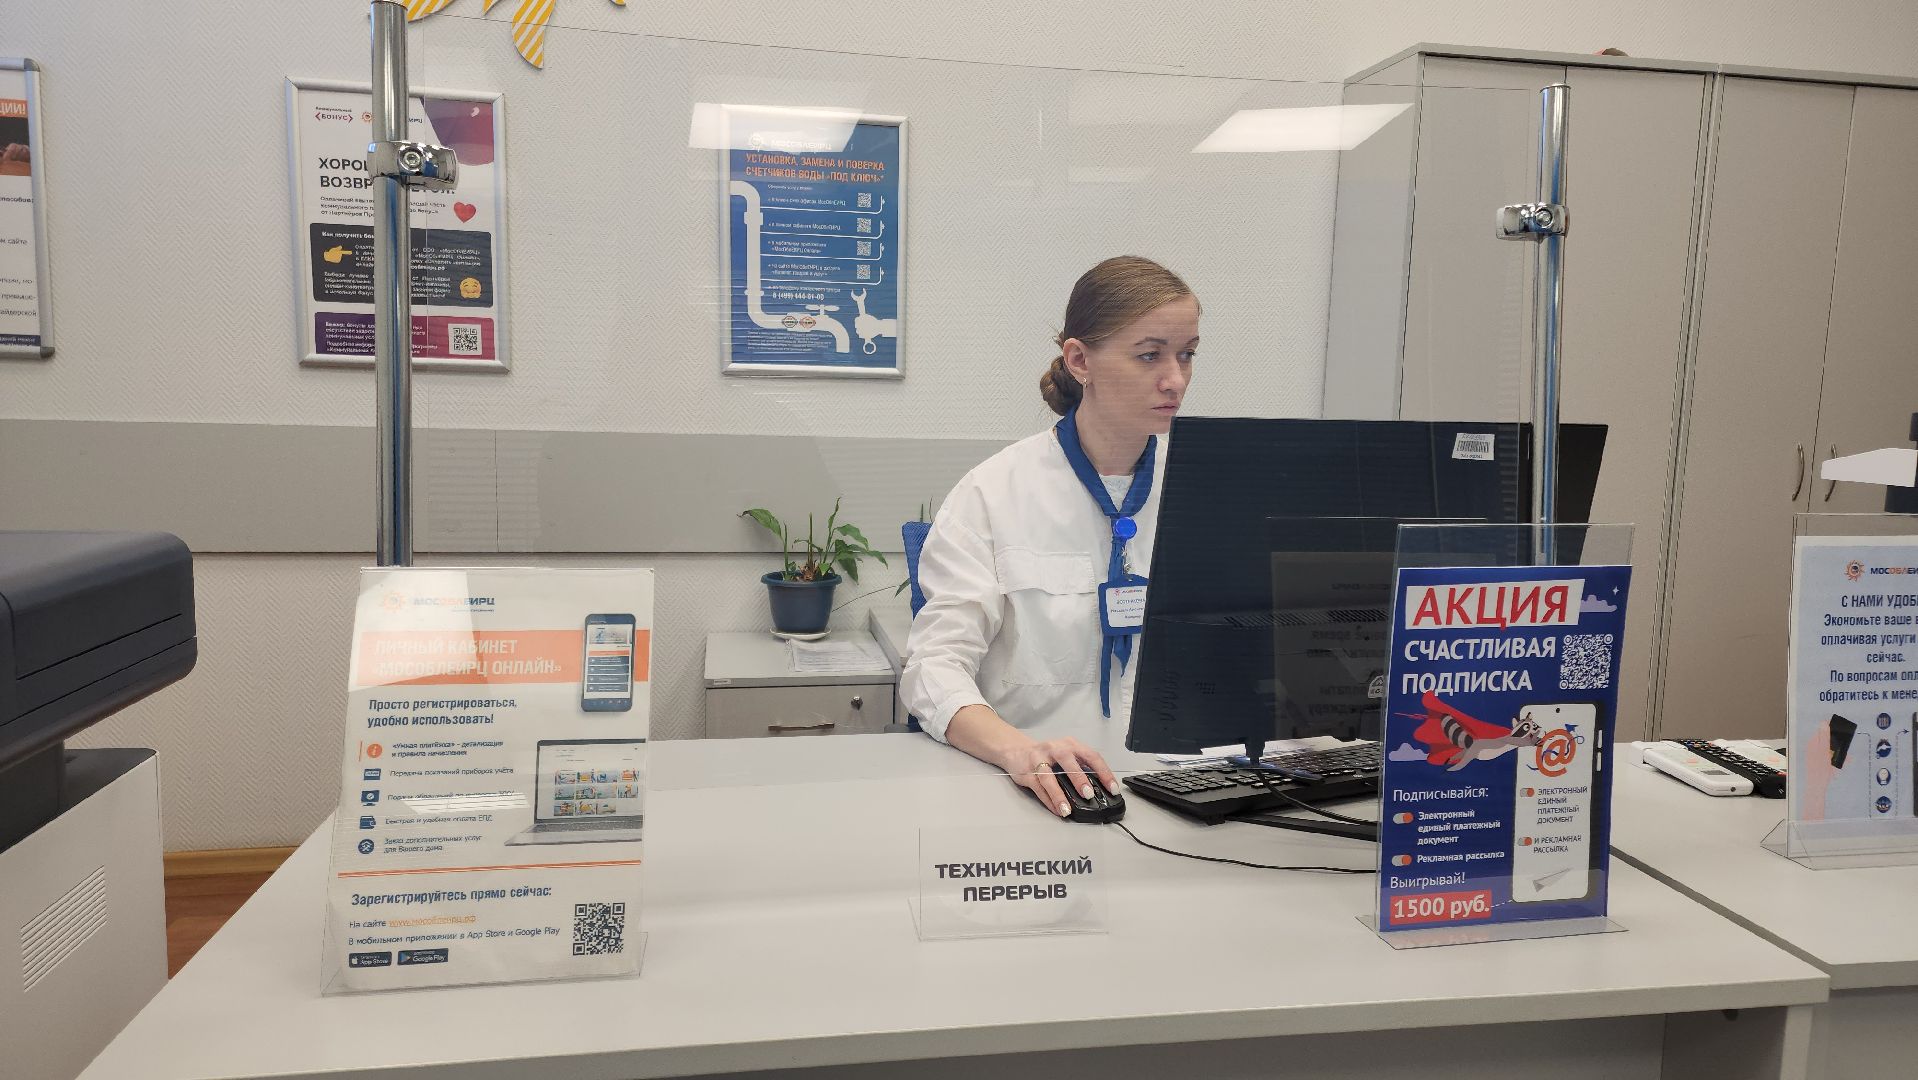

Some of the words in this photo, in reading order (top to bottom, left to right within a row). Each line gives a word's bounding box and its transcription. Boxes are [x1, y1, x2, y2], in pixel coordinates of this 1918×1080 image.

[745, 153, 799, 166] УСТАНОВКА,
[800, 156, 835, 167] ЗАМЕНА
[837, 158, 844, 167] И
[845, 159, 885, 171] ПОВЕРКА
[745, 166, 796, 178] СЧЕТЧИКОВ
[798, 169, 825, 181] ВОДЫ
[1412, 585, 1569, 631] АКЦИЯ
[1841, 595, 1849, 608] С
[1851, 594, 1884, 608] НАМИ
[1823, 613, 1881, 627] Экономьте
[1884, 614, 1912, 626] ваше
[375, 638, 446, 656] ЛИЧНЫЙ
[448, 639, 518, 655] КАБИНЕТ
[1821, 633, 1878, 646] оплачивая
[1880, 633, 1916, 647] услуги
[1404, 636, 1557, 662] СЧАСТЛИВАЯ
[1866, 651, 1907, 664] сейчас.
[491, 656, 562, 675] ОНЛАЙН»
[1402, 669, 1533, 696] ПОДПИСКА
[1830, 669, 1845, 683] По
[1847, 670, 1898, 685] вопросам
[1819, 689, 1880, 704] обратитесь
[1882, 690, 1889, 701] к
[369, 699, 410, 712] Просто
[412, 698, 518, 712] регистрироваться,
[367, 714, 409, 729] удобно
[411, 713, 494, 727] использовать!
[1393, 785, 1489, 802] Подписывайся:
[1537, 785, 1588, 796] ЭЛЕКТРОННЫЙ
[1537, 796, 1568, 805] ЕДИНЫЙ
[1418, 809, 1476, 821] Электронный
[1537, 804, 1580, 815] ПЛАТЕЖНЫЙ
[1417, 823, 1451, 833] единый
[1452, 820, 1501, 831] платежный
[1536, 815, 1574, 825] ДОКУМЕНТ
[1416, 835, 1460, 846] документ
[1540, 834, 1582, 844] РЕКЛАМНАЯ
[1533, 845, 1569, 854] РАССЫЛКА
[1416, 853, 1464, 864] Рекламная
[1465, 851, 1505, 863] рассылка
[934, 855, 1093, 879] ТЕХНИЧЕСКИЙ
[1390, 872, 1466, 890] Выигрывай!
[351, 889, 467, 907] Зарегистрируйтесь
[470, 888, 506, 902] прямо
[510, 885, 552, 898] сейчас:
[963, 883, 1068, 902] ПЕРЕРЫВ
[1394, 897, 1445, 919] 1500
[1450, 893, 1490, 919] руб.
[349, 920, 361, 928] На
[362, 919, 387, 928] сайте
[356, 936, 403, 945] мобильном
[405, 933, 458, 943] приложении
[467, 931, 483, 940] App
[485, 929, 506, 938] Store
[515, 927, 542, 938] Google
[544, 926, 561, 936] Play
